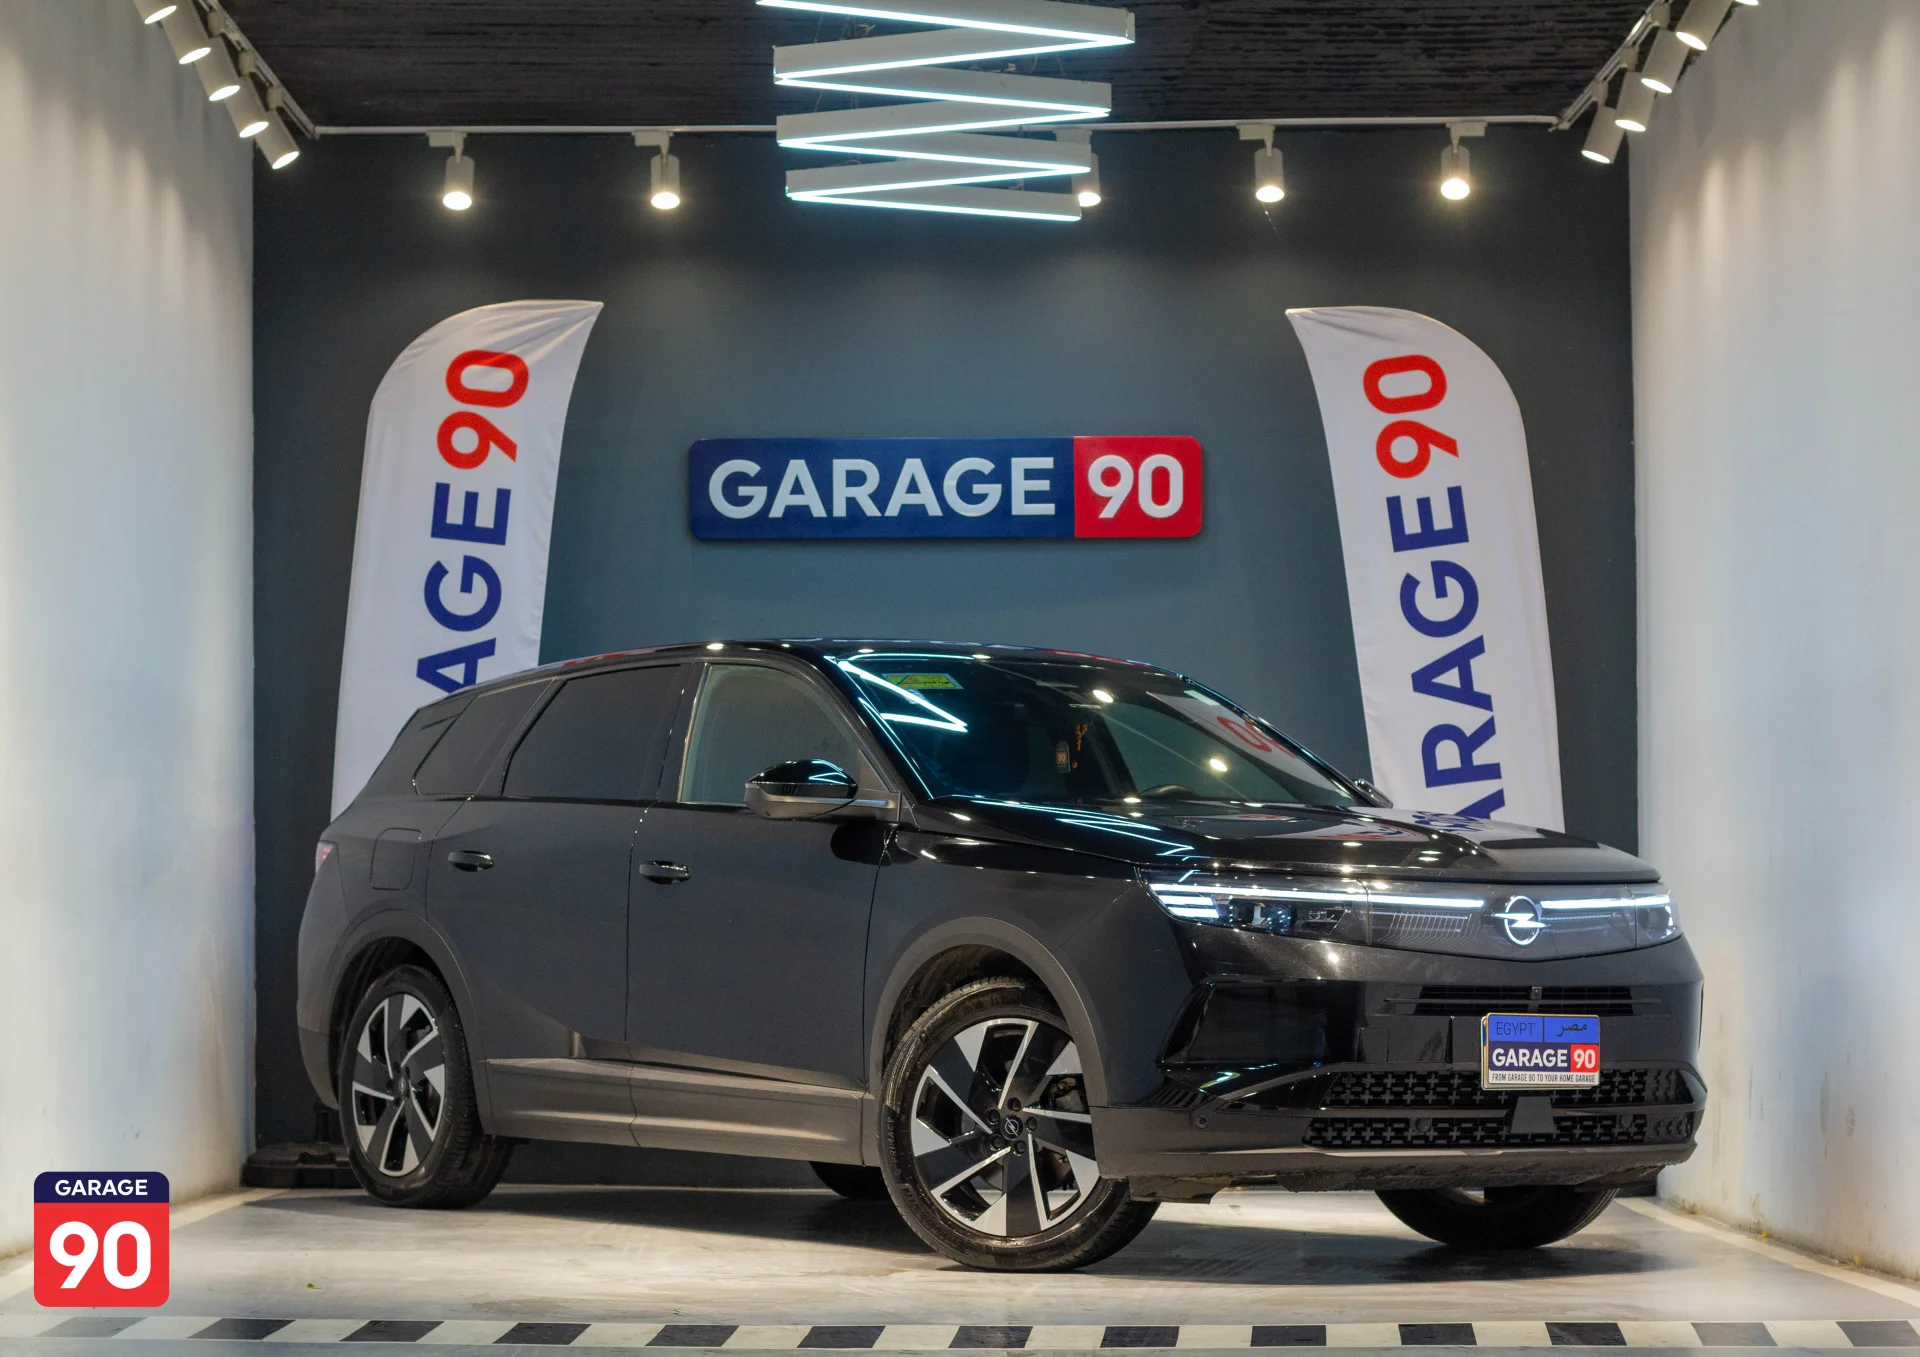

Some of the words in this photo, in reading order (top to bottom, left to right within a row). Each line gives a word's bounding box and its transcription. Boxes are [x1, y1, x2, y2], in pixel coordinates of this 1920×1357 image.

[708, 457, 1056, 519] GARAGE
[1087, 453, 1184, 519] 90
[1496, 1022, 1535, 1036] EGYPT
[1555, 1023, 1588, 1037] مصر
[1492, 1048, 1568, 1068] GARAGE
[1573, 1049, 1596, 1069] 90
[1492, 1073, 1506, 1082] FROM
[1508, 1073, 1527, 1082] GARAGE
[1529, 1074, 1536, 1082] 90
[1537, 1074, 1544, 1082] TO
[1545, 1074, 1558, 1083] YOUR
[1560, 1074, 1574, 1083] HOME
[1575, 1074, 1596, 1083] GARAGE
